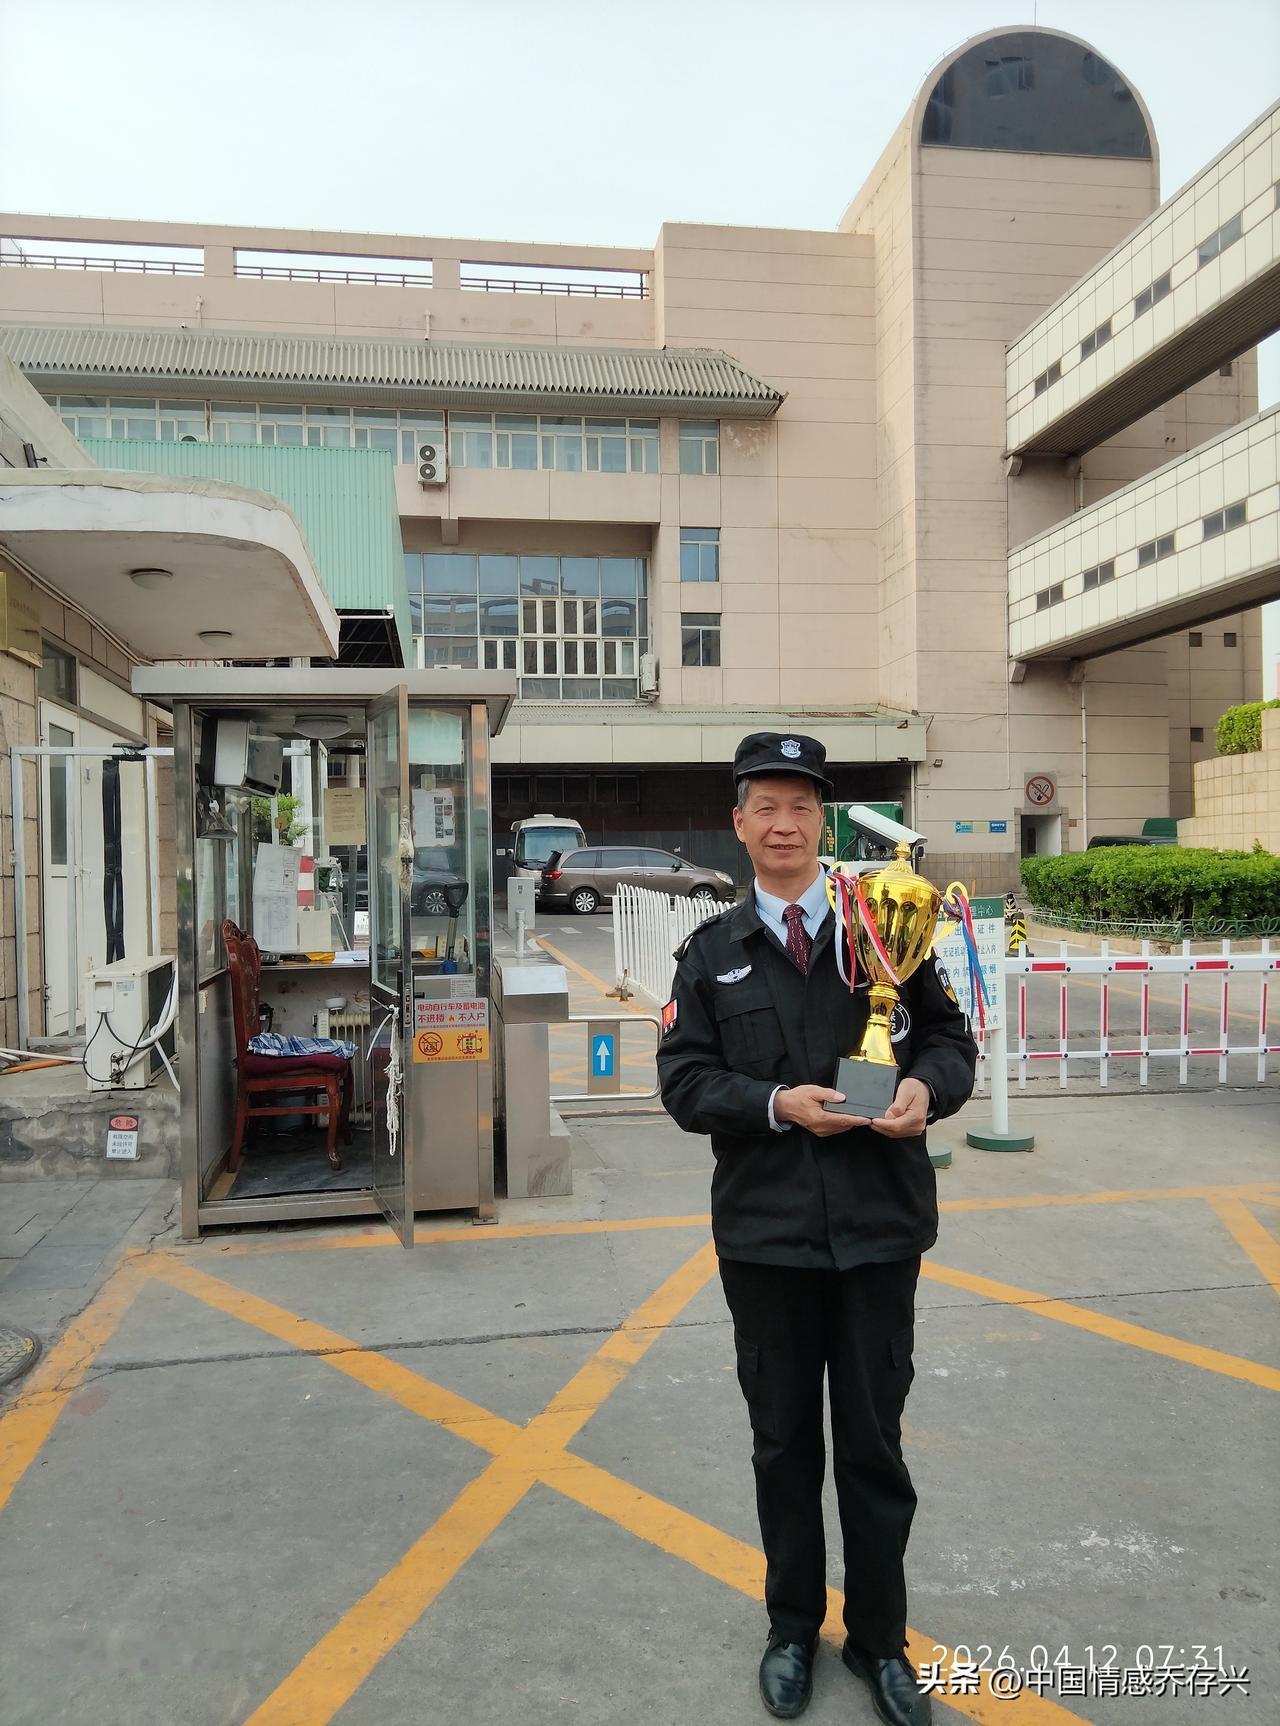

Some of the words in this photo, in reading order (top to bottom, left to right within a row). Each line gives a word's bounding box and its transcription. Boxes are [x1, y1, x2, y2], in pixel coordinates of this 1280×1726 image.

[417, 1002, 485, 1011] 电动自行车及蓄电池
[417, 1014, 445, 1023] 不进楼
[458, 1012, 485, 1021] 不入户
